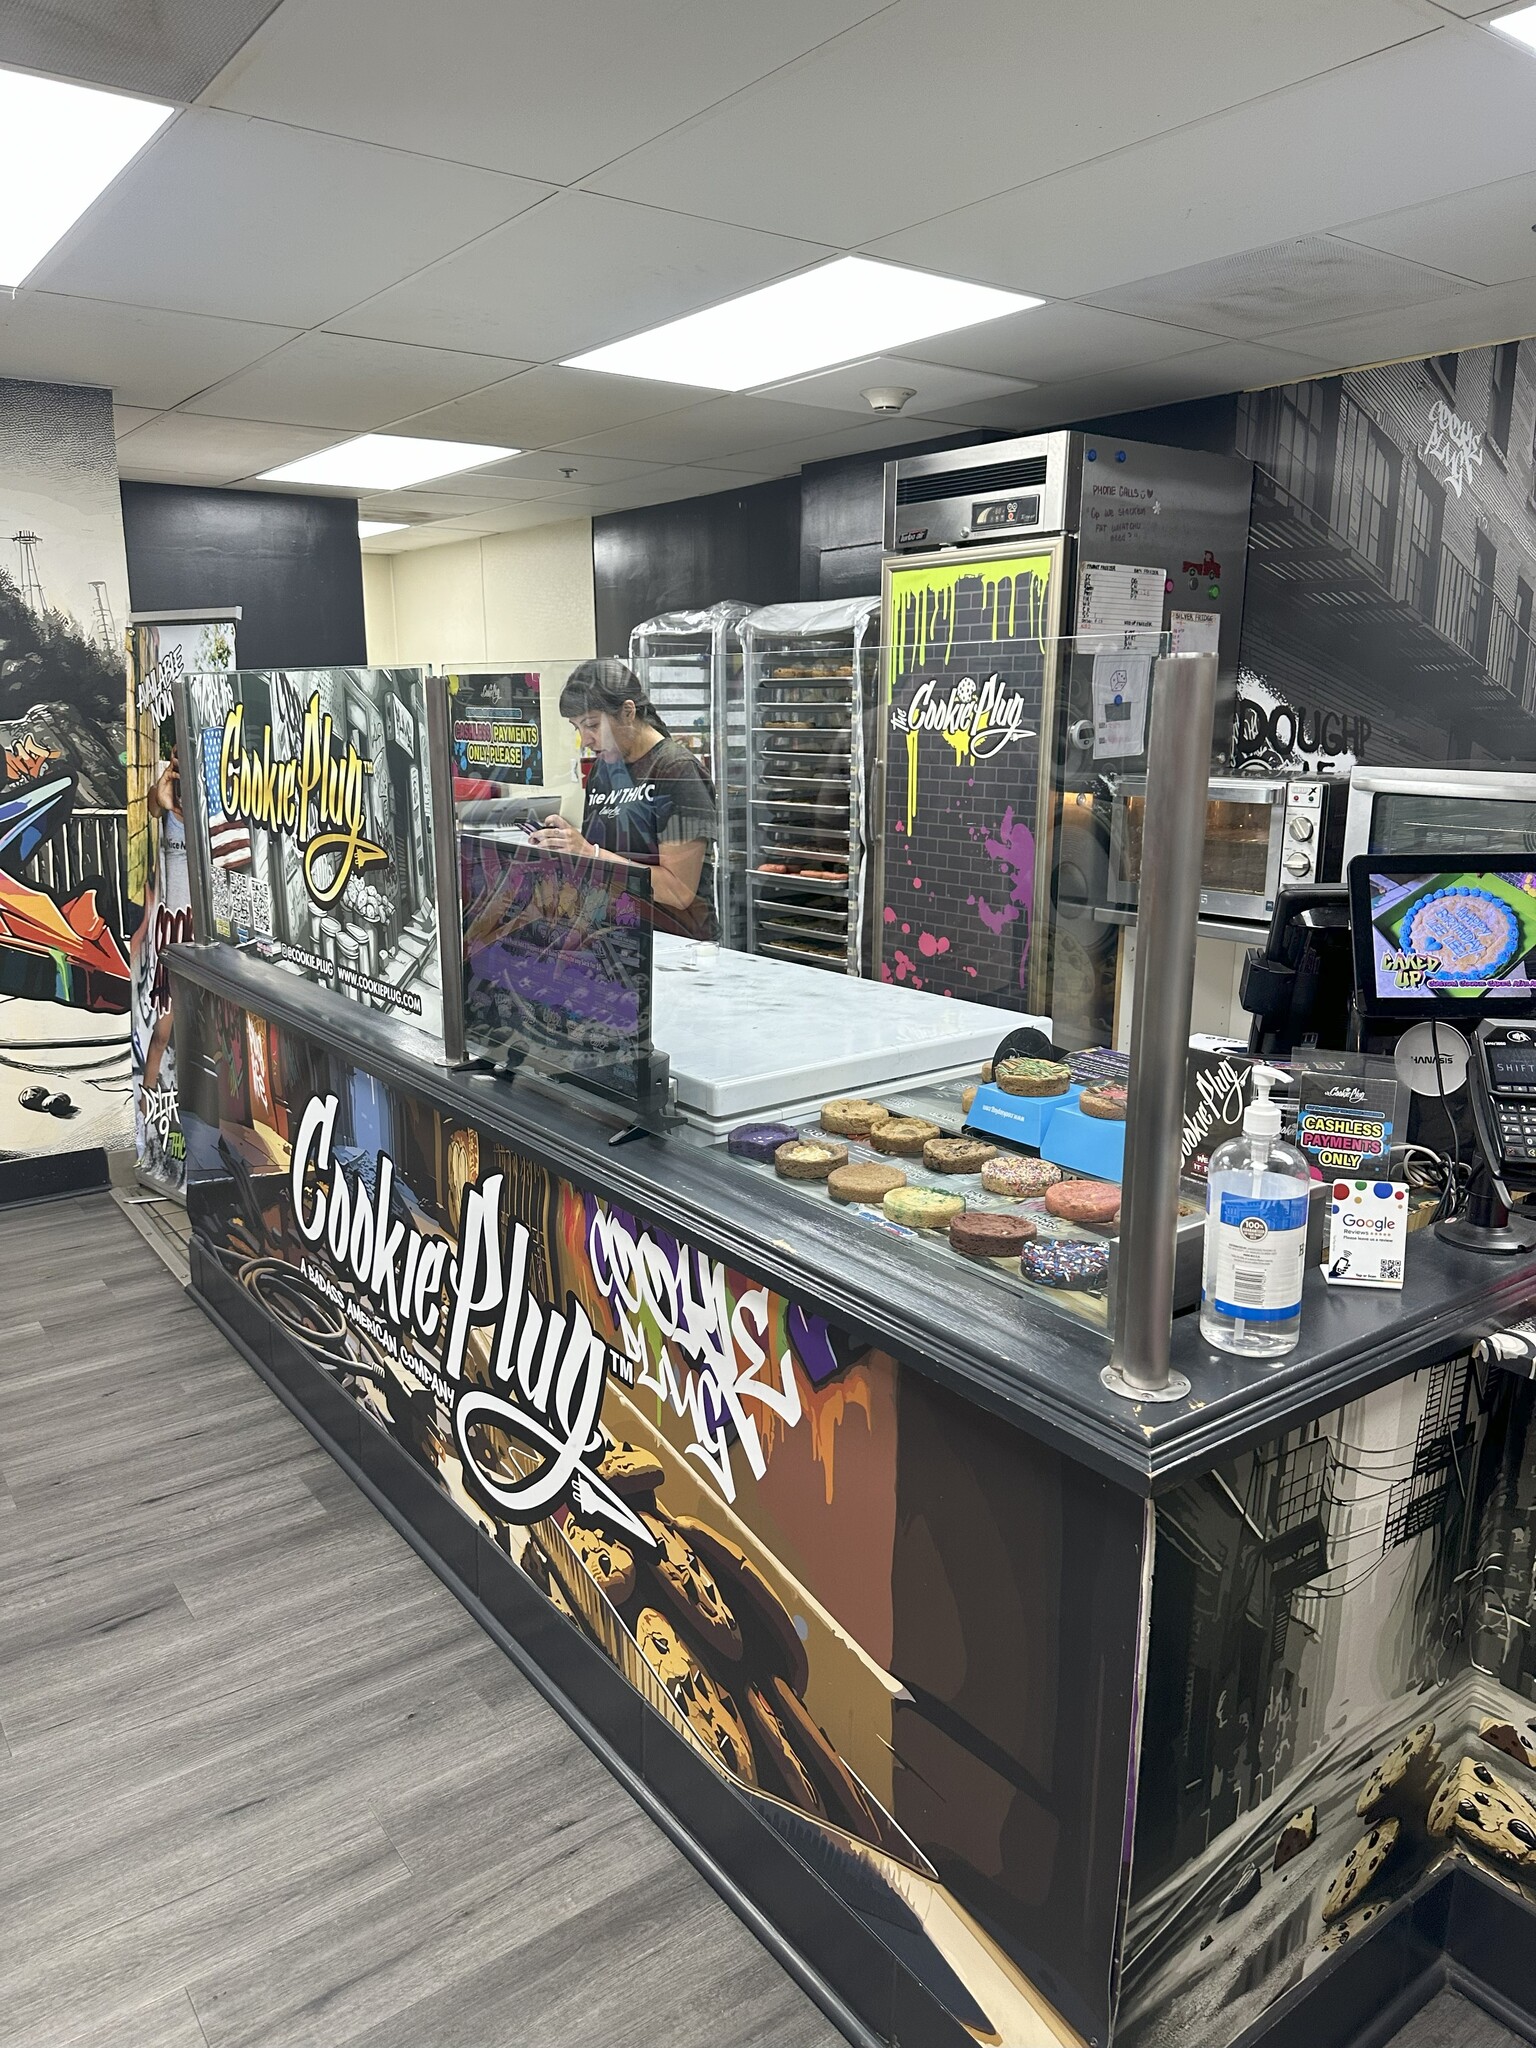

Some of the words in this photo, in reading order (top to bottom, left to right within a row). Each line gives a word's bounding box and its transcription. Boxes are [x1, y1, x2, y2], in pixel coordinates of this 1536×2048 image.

[1092, 485, 1116, 496] PHONE
[1119, 486, 1139, 498] CALLS
[136, 644, 184, 713] AVAILABLE
[907, 679, 972, 734] Cookie
[969, 673, 1037, 759] Plug
[455, 722, 491, 742] CASHLESS
[493, 724, 538, 745] PAYMENTS
[490, 745, 521, 766] PLEASE
[221, 703, 298, 833] Cookie
[297, 691, 389, 902] Plug
[1435, 907, 1487, 955] BIRTHDAY
[1456, 906, 1493, 937] HAPPY
[1381, 951, 1443, 973] CAKED
[338, 966, 421, 1013] WWW.COOKIEPLUG.COM
[1394, 970, 1426, 989] UP
[140, 1084, 181, 1124] DELTA
[1196, 1060, 1252, 1125] Plug
[159, 1114, 169, 1152] 9
[1302, 1132, 1382, 1154] PAYMENTS
[1304, 1117, 1382, 1138] CASHLESS
[1321, 1152, 1360, 1168] ONLY
[1245, 1219, 1264, 1230] 100%
[1342, 1213, 1395, 1232] Google
[293, 1094, 450, 1337] Cookie
[445, 1174, 658, 1549] Plug
[300, 1258, 308, 1278] A
[309, 1265, 345, 1309] BADASS
[346, 1299, 398, 1358] AMERICAN
[400, 1345, 455, 1409] COMPANY
